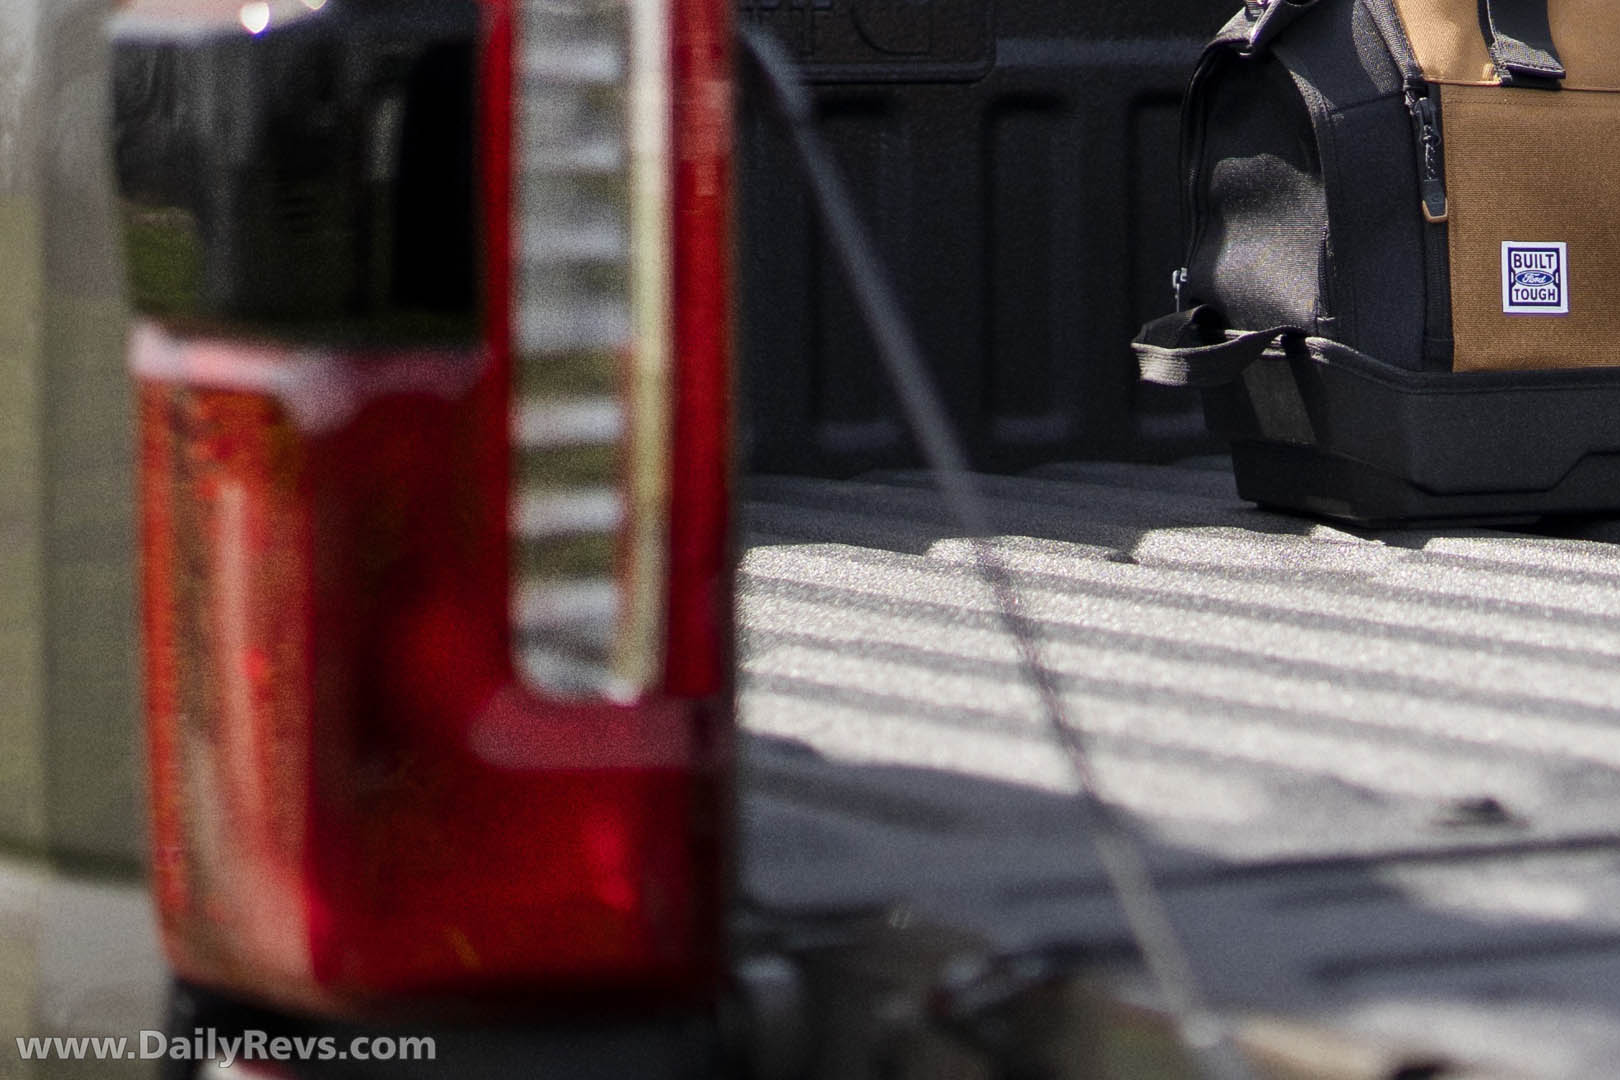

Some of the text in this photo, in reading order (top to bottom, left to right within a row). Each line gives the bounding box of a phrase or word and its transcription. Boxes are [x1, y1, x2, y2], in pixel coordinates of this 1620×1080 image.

[1513, 253, 1554, 269] BUILT
[1522, 272, 1547, 283] Ford
[1514, 288, 1556, 301] TOUGH
